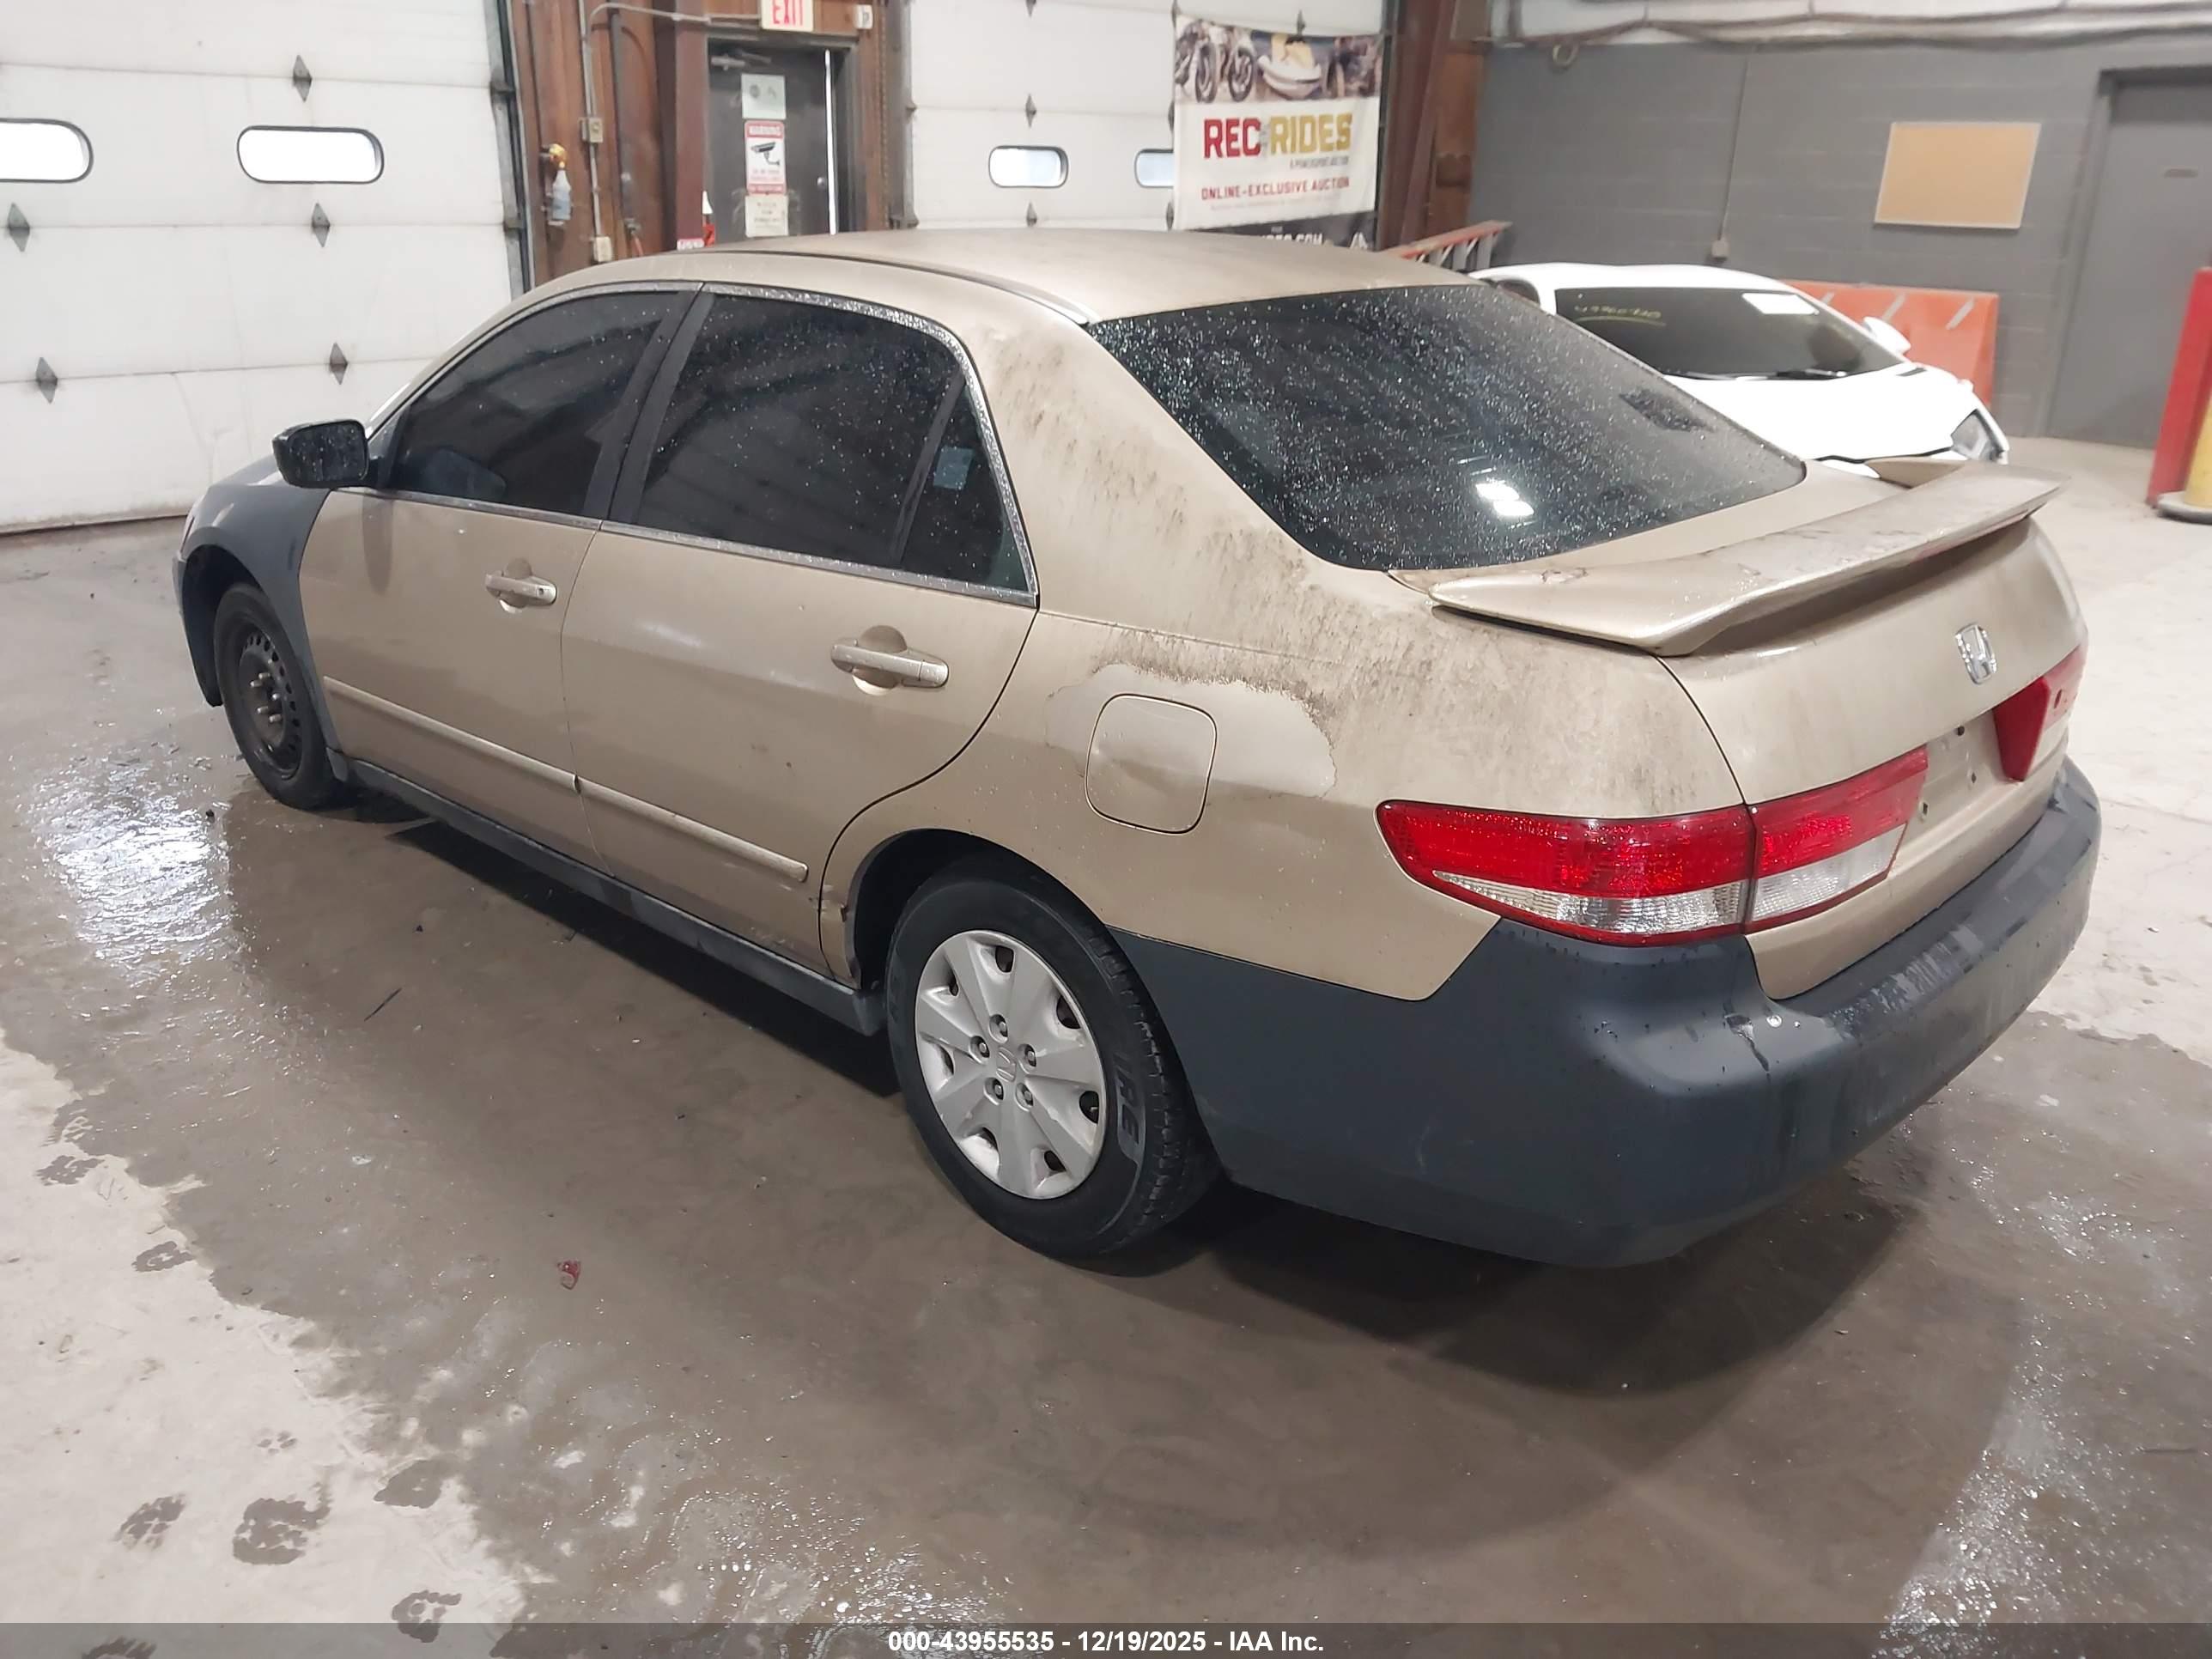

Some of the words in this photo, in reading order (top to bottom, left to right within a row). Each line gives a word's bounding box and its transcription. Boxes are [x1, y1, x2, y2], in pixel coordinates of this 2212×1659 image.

[1204, 118, 1261, 158] REC
[1270, 113, 1352, 154] RIDES
[1311, 176, 1350, 191] AUCTION
